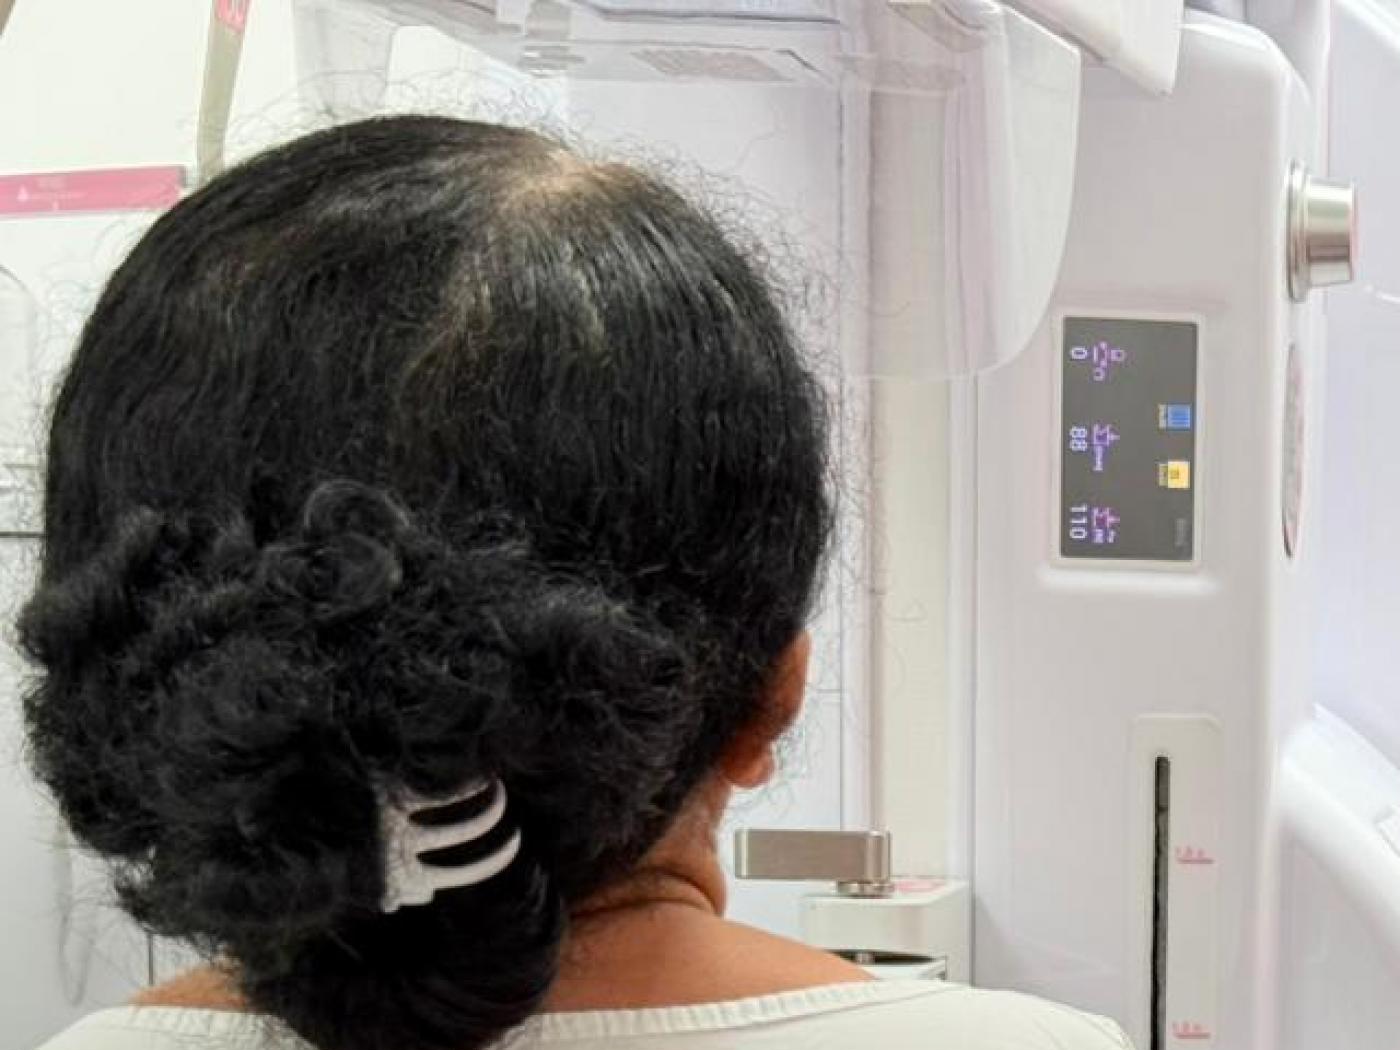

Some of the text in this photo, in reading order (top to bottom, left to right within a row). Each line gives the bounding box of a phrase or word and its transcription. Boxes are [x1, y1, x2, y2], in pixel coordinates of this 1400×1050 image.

[1069, 347, 1089, 360] 0
[1069, 426, 1089, 452] 88
[1069, 503, 1089, 541] 110
